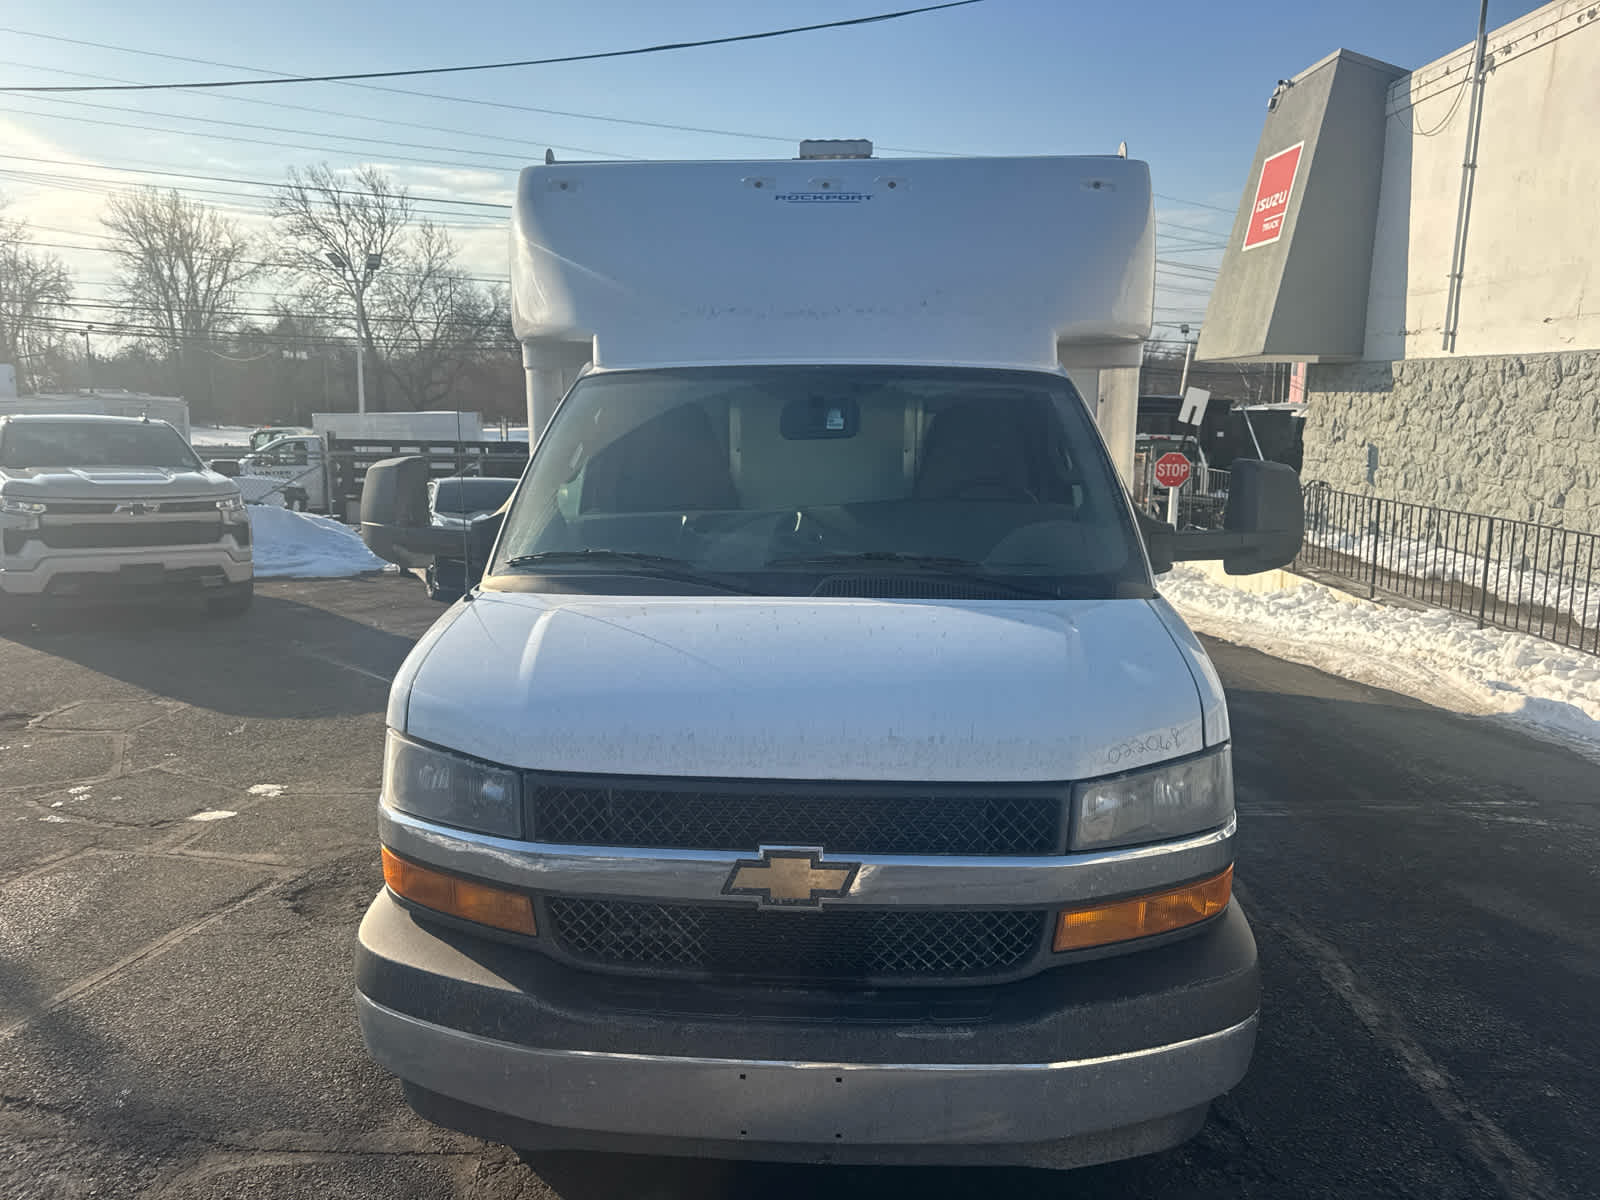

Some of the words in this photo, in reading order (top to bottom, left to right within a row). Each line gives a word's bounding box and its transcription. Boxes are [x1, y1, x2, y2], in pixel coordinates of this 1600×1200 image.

[775, 193, 873, 201] ROCKPORT
[1257, 191, 1287, 213] ISUZU
[1157, 463, 1188, 477] STOP
